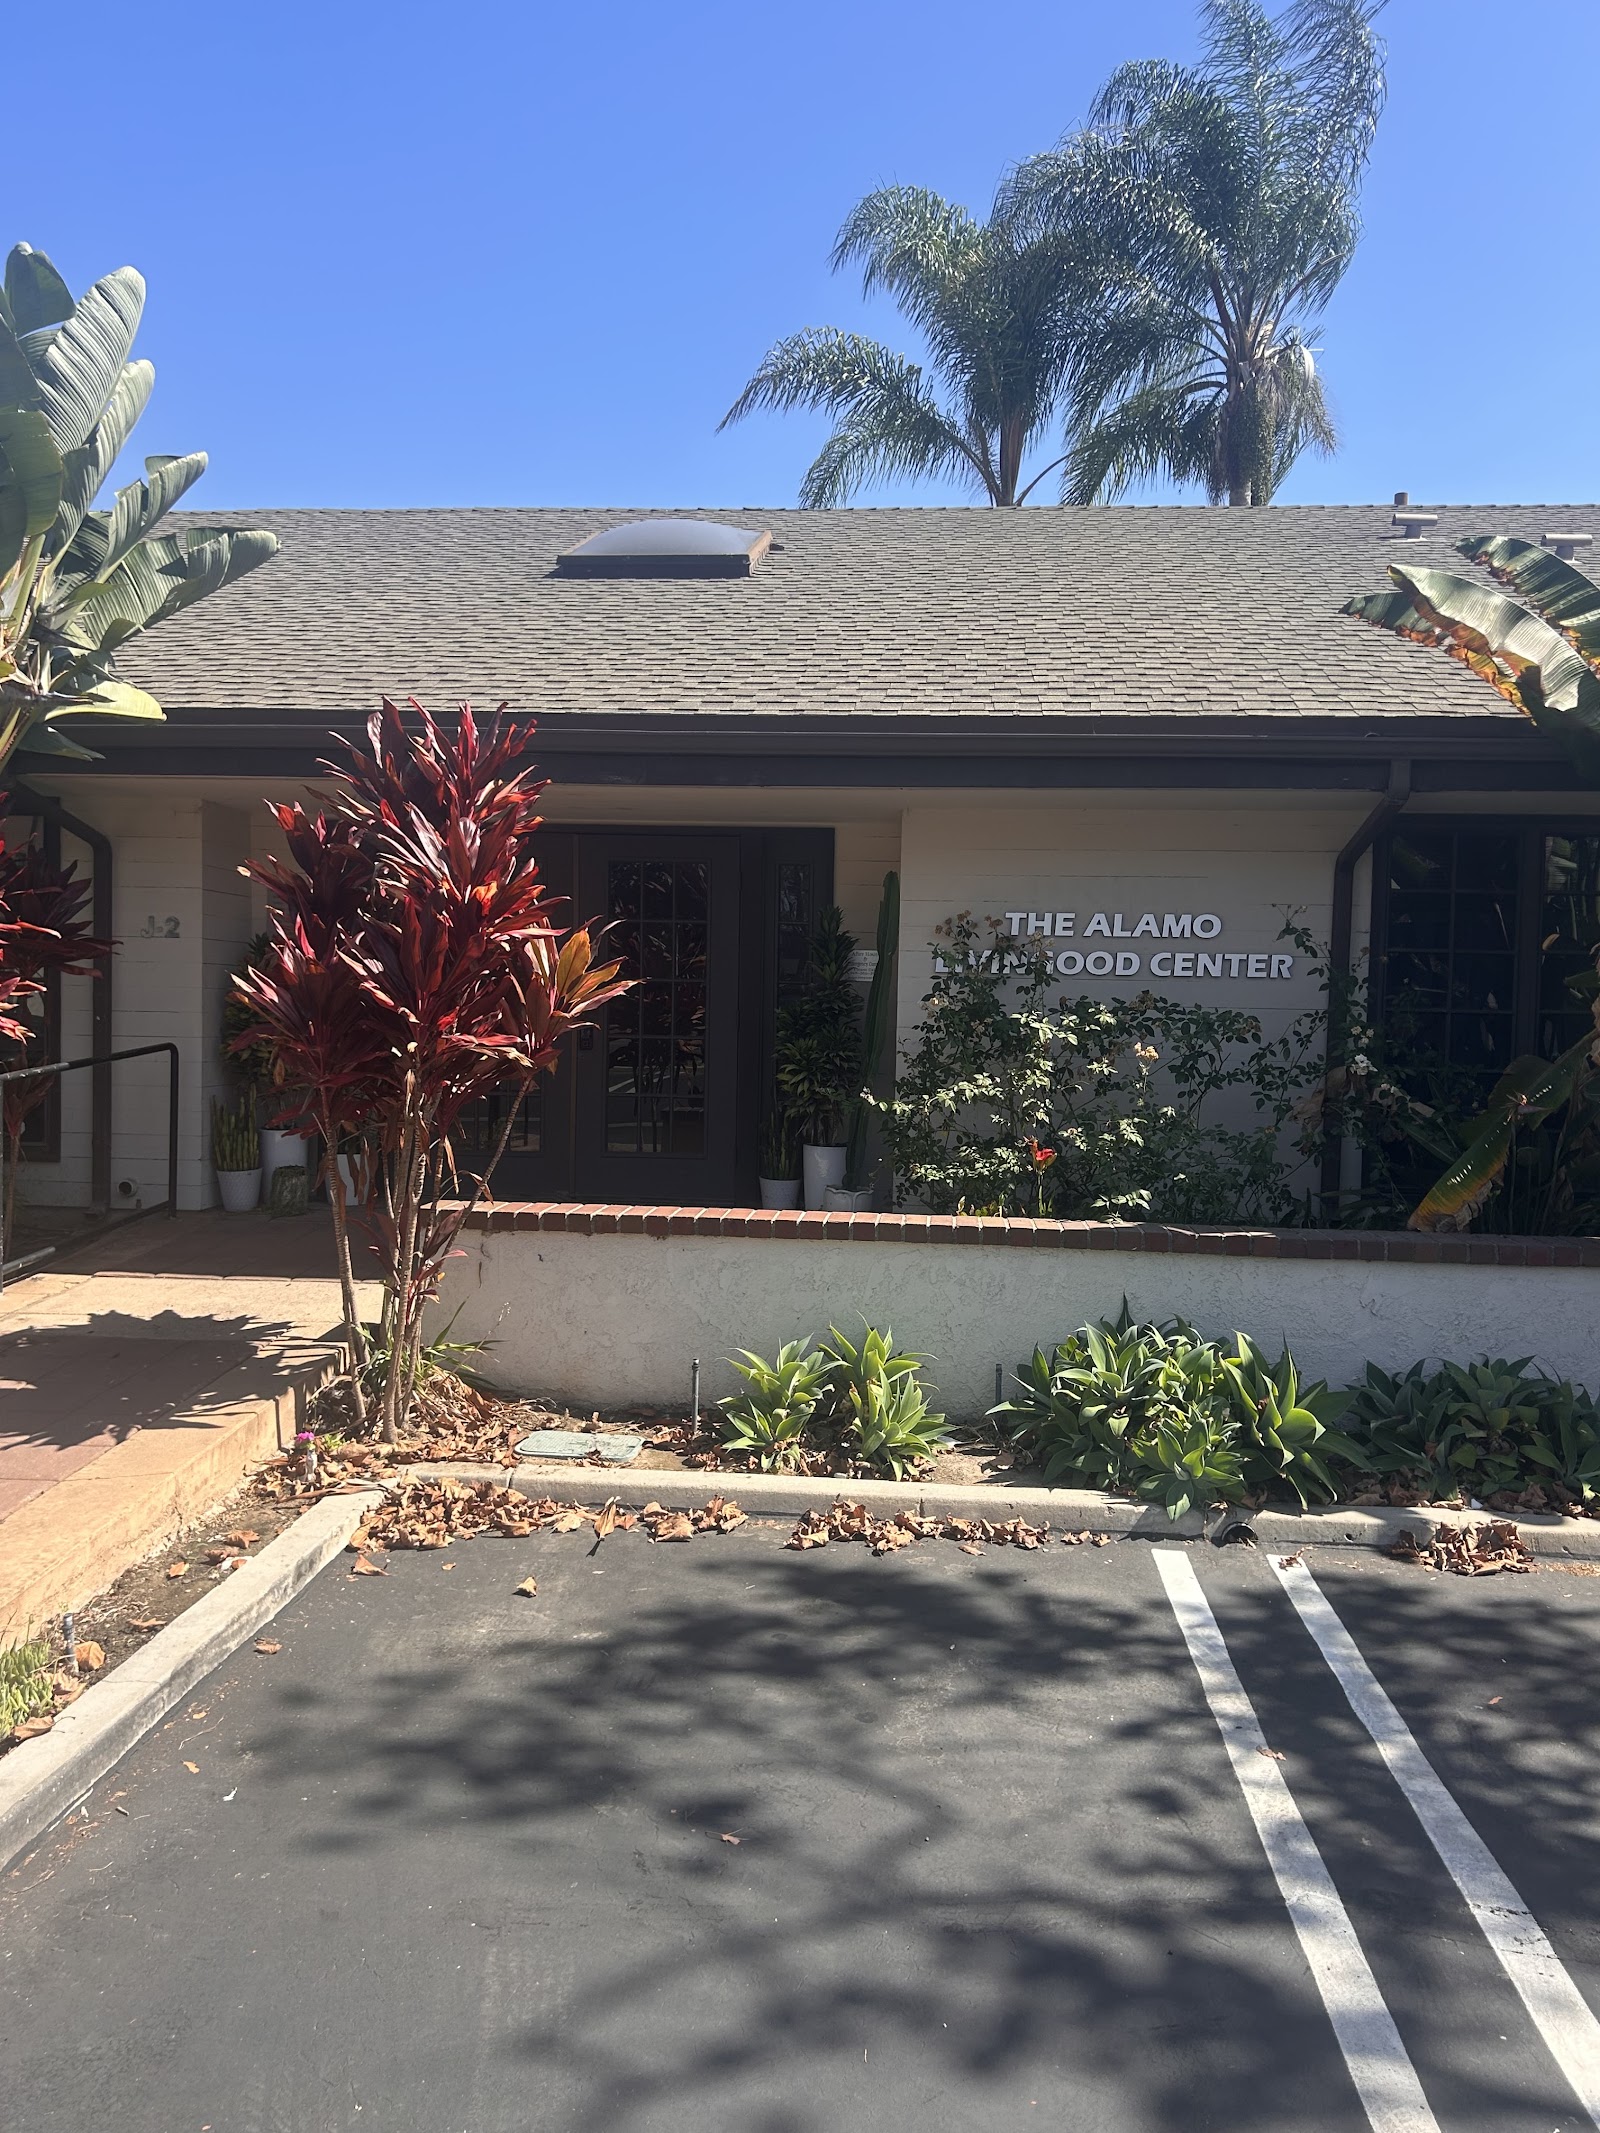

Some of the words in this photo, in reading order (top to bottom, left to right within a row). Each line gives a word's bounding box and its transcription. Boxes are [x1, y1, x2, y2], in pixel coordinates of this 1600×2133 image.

[1005, 912, 1076, 936] THE
[1083, 913, 1222, 939] ALAMO
[1150, 952, 1293, 979] CENTER
